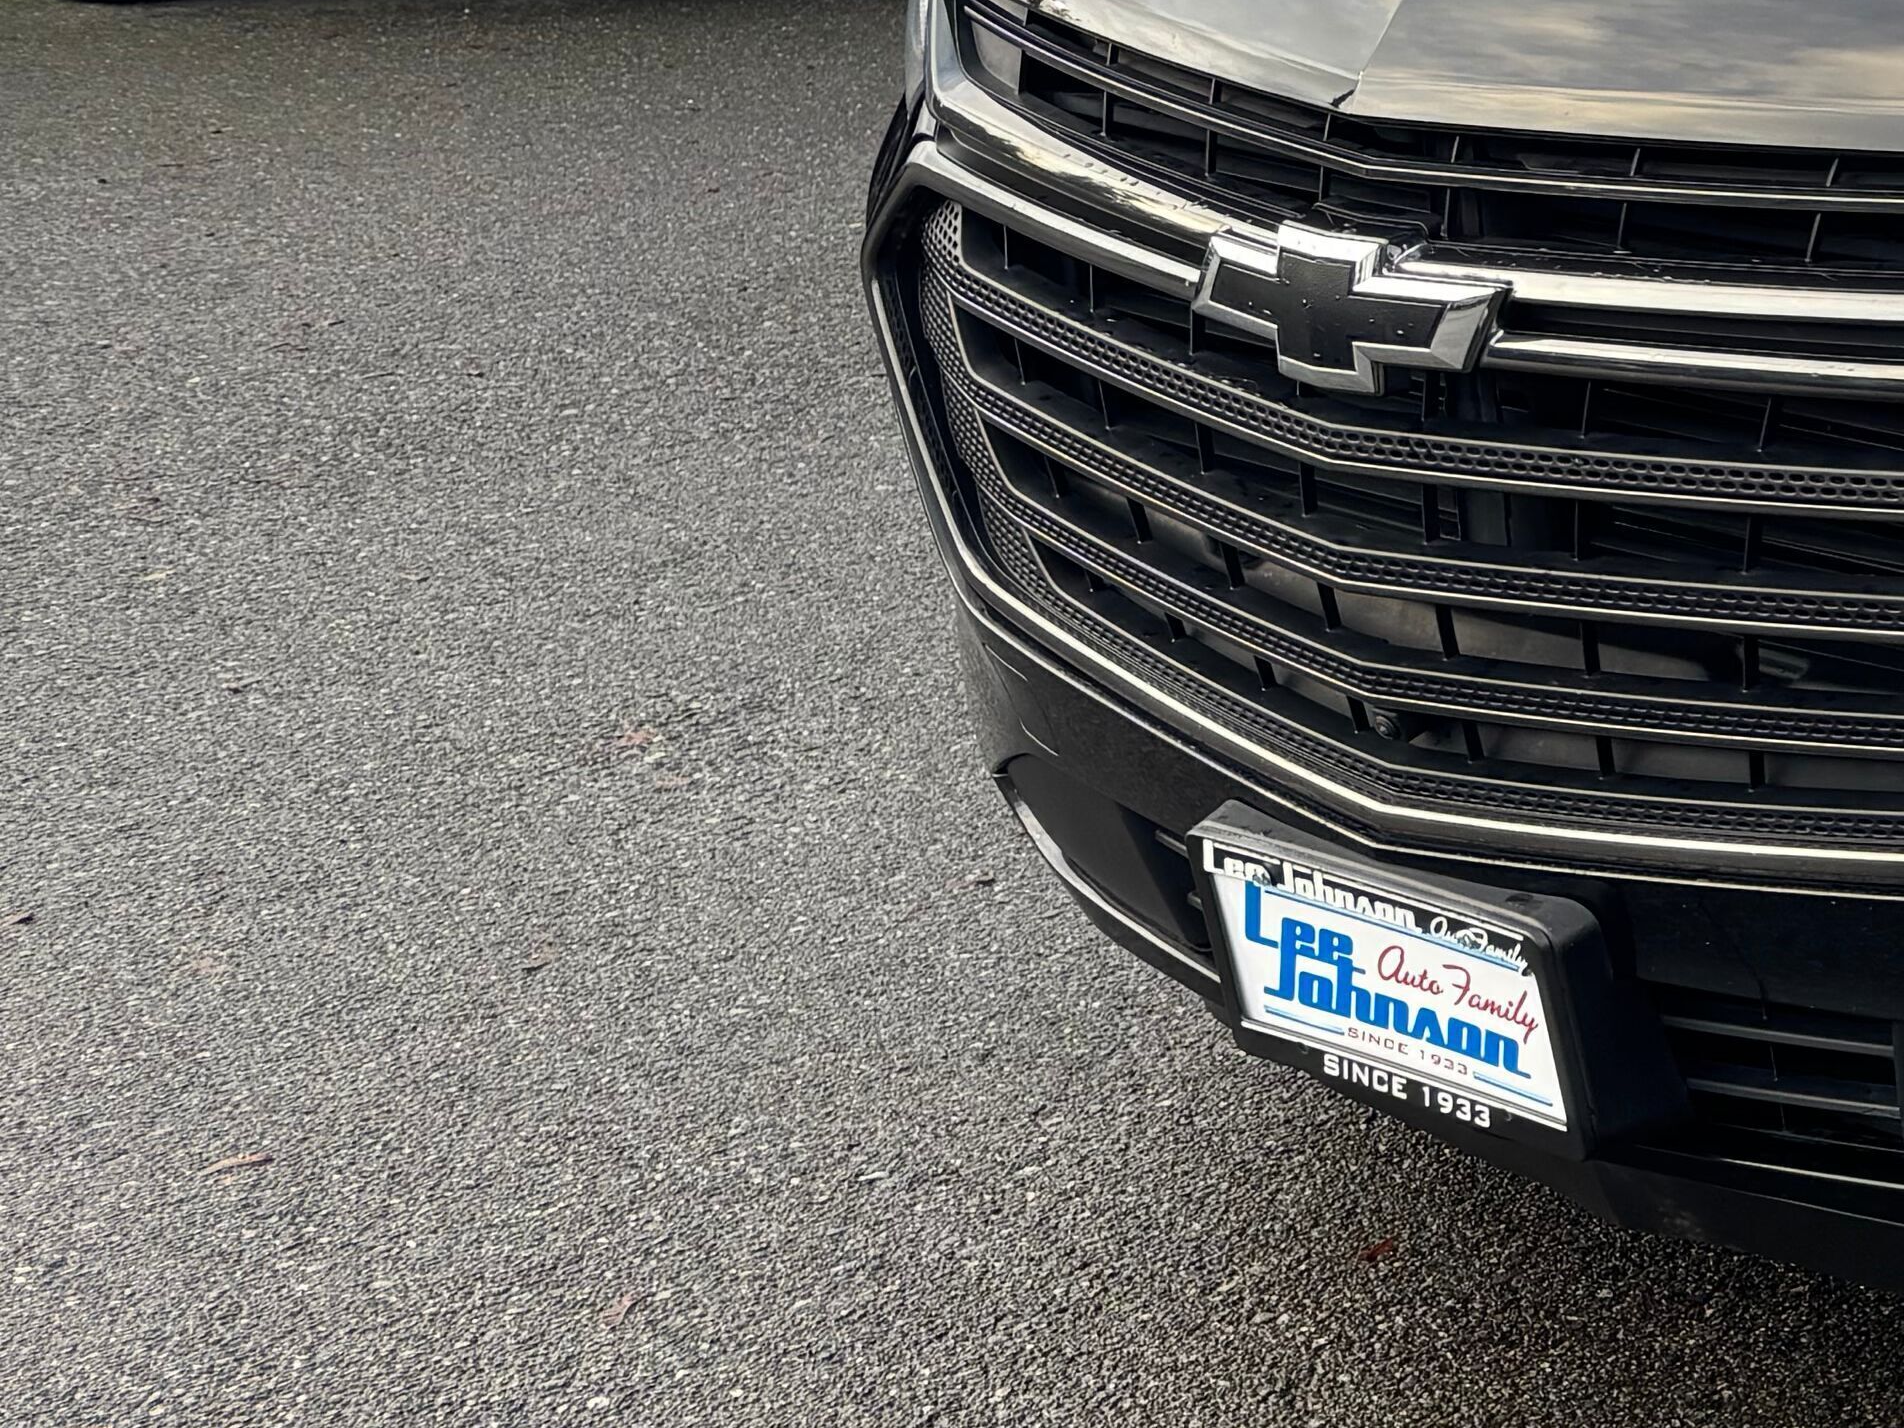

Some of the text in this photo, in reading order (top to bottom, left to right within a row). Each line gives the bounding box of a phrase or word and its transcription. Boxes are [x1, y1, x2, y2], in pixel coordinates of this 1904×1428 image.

[1203, 839, 1271, 885] Lee
[1277, 861, 1423, 933] Johnson
[1244, 878, 1366, 974] Lee
[1264, 944, 1532, 1079] Johnson
[1377, 946, 1540, 1043] Auto Family
[1322, 1054, 1492, 1129] SINCE 1933
[1346, 1027, 1469, 1077] SINCE 1933
